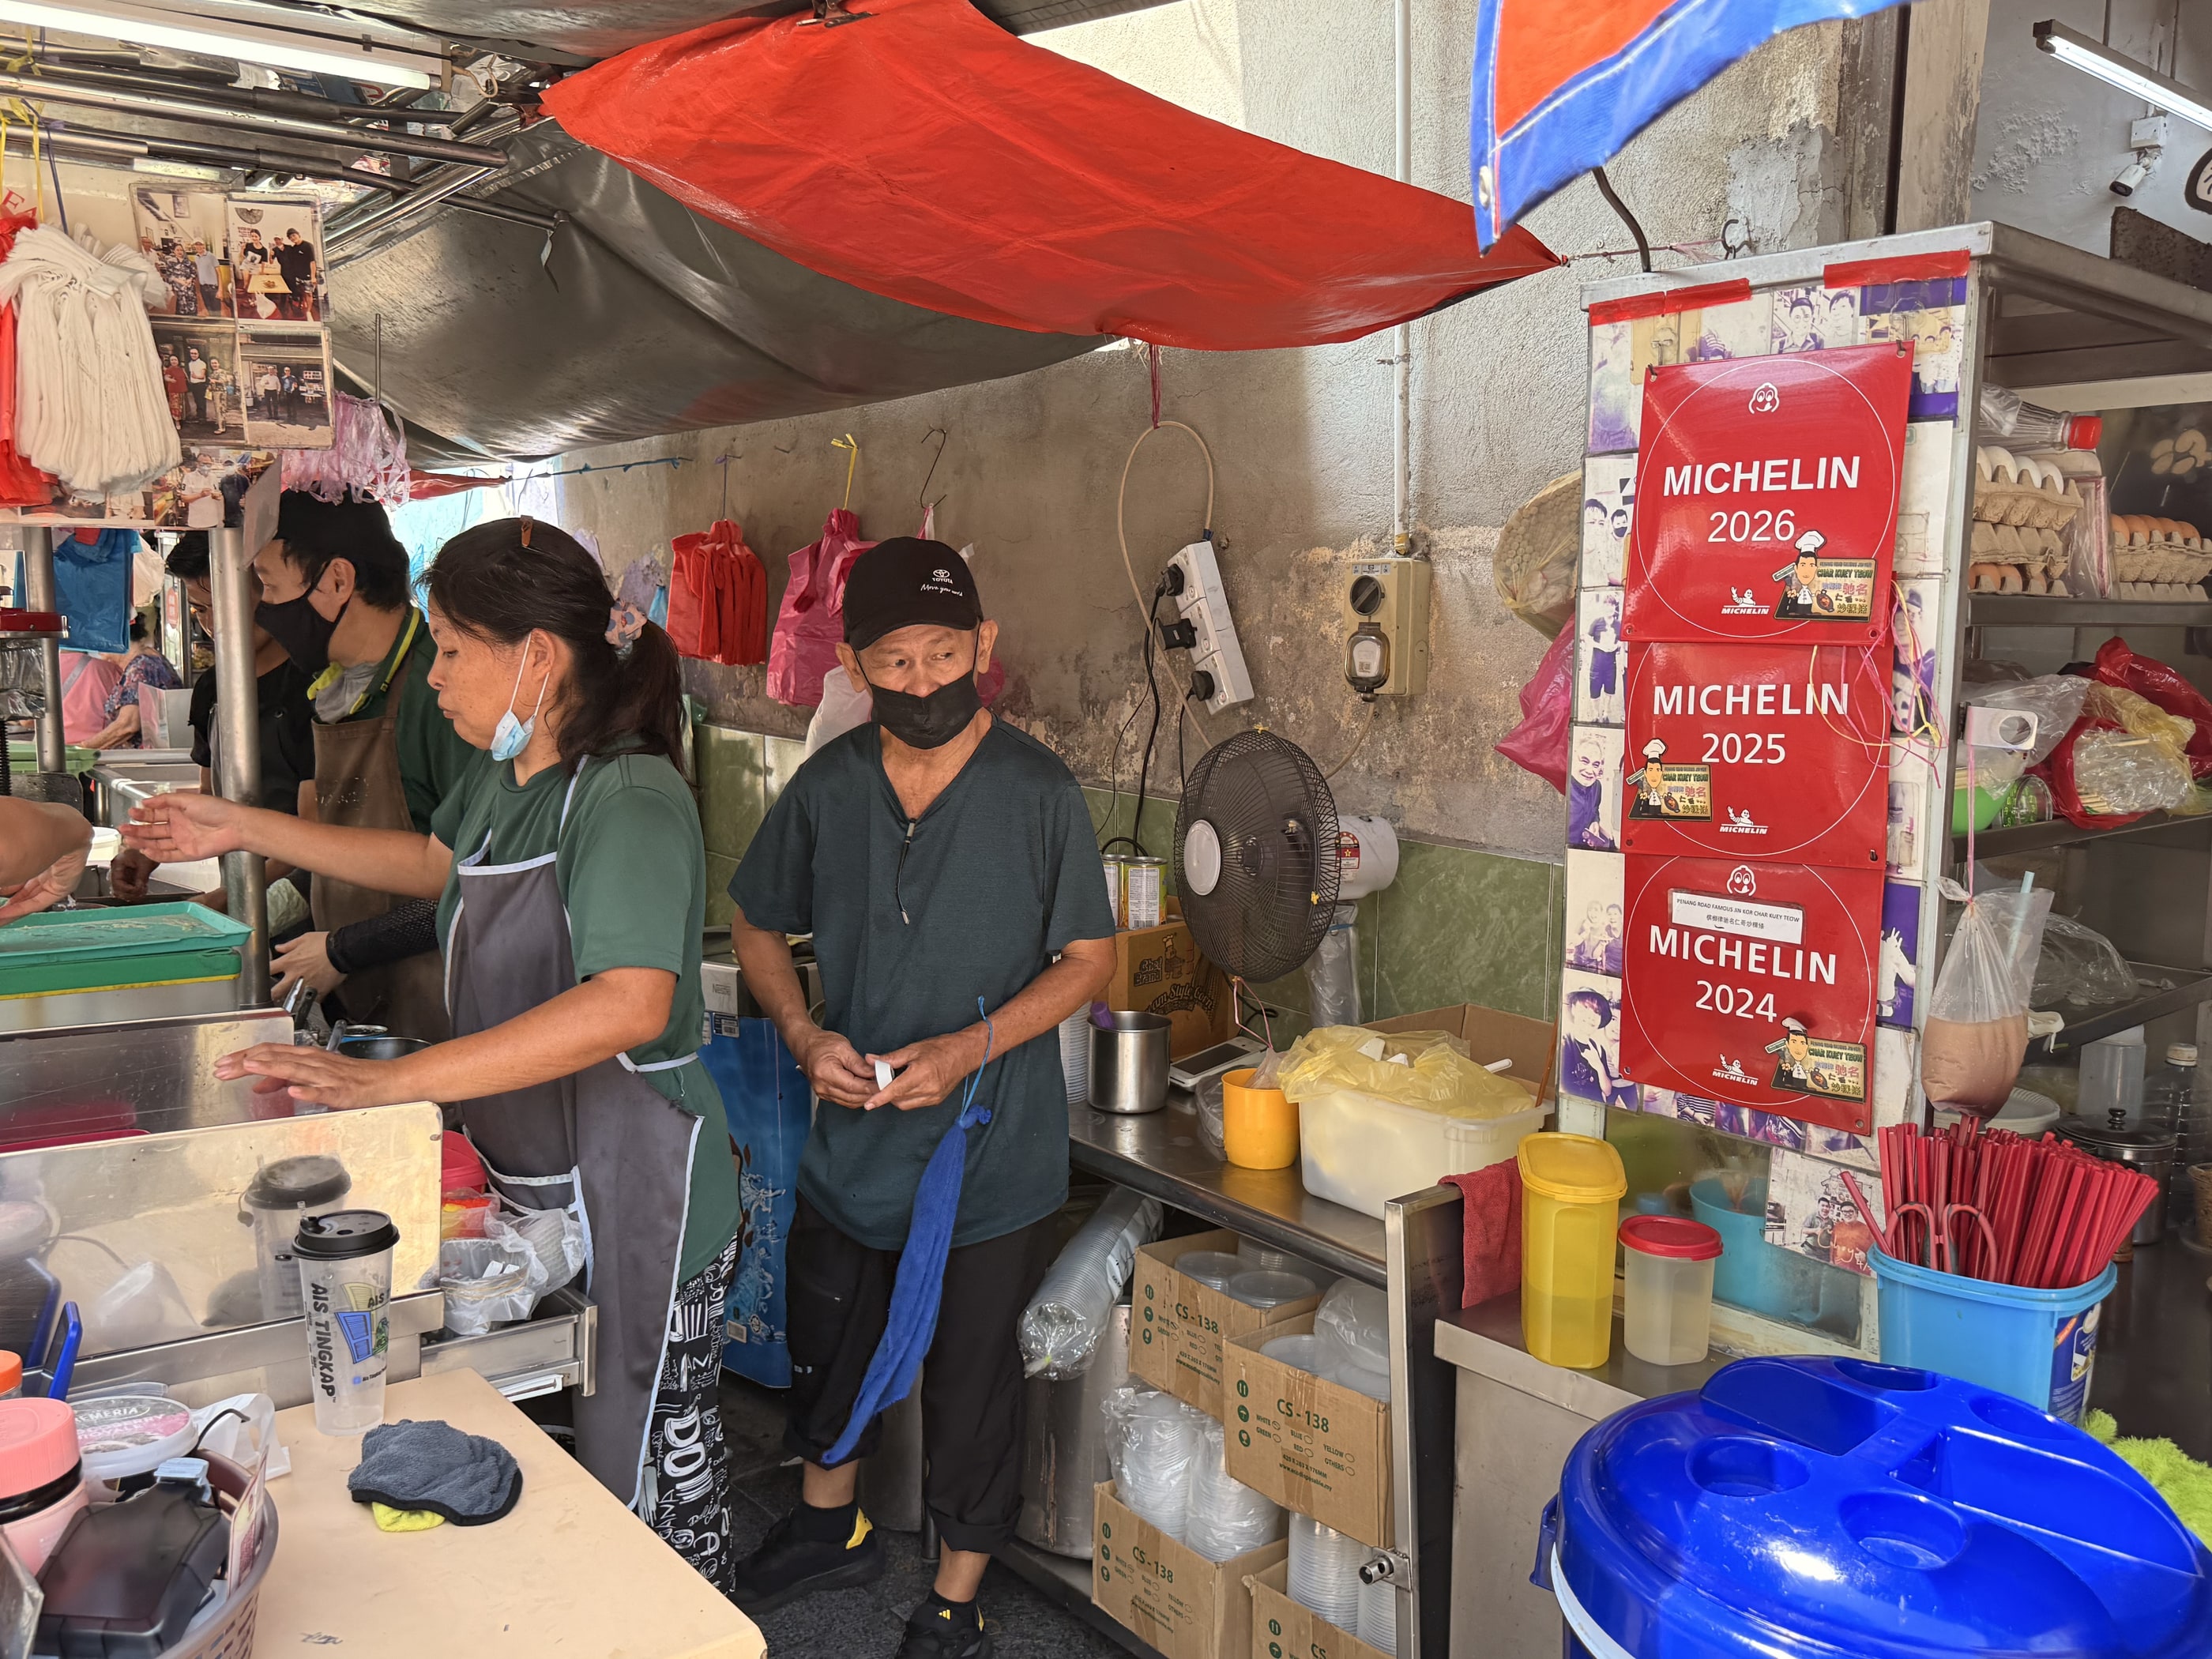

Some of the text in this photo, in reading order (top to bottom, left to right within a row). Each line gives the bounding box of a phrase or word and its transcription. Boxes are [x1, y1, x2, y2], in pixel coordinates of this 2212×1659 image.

[1664, 456, 1860, 497] MICHELIN
[1708, 510, 1795, 543] 2026
[1721, 607, 1770, 615] MICHELIN
[1653, 683, 1849, 716] MICHELIN
[1702, 732, 1786, 764] 2025
[1719, 826, 1768, 835] MICHELIN
[1676, 898, 1696, 907] PENANG
[1712, 904, 1733, 912] FAMOUS
[1650, 924, 1836, 985] MICHELIN
[1140, 956, 1162, 972] Chef
[1134, 971, 1162, 987] Brand
[1170, 983, 1193, 1000] Style
[1194, 986, 1213, 1011] Corn
[1695, 980, 1778, 1023] 2024
[1808, 1048, 1826, 1058] CHAR
[1826, 1050, 1845, 1060] KUEY
[1712, 1068, 1759, 1086] MICHELIN
[311, 1283, 329, 1314] AIS
[367, 1293, 385, 1308] AIS
[1176, 1303, 1188, 1320] CS
[1198, 1315, 1219, 1334] 138
[1256, 1414, 1271, 1426] WHITE
[1277, 1398, 1293, 1417] CS
[1305, 1410, 1329, 1433] 138
[1256, 1427, 1272, 1439] GREEN
[1291, 1430, 1303, 1440] BLUE
[1293, 1443, 1304, 1453] RED
[1323, 1444, 1344, 1458] YELLOW
[1325, 1458, 1345, 1471] OTHERS
[1133, 1546, 1146, 1564] CS
[1154, 1561, 1173, 1584] 138
[1168, 1593, 1183, 1607] YELLOW
